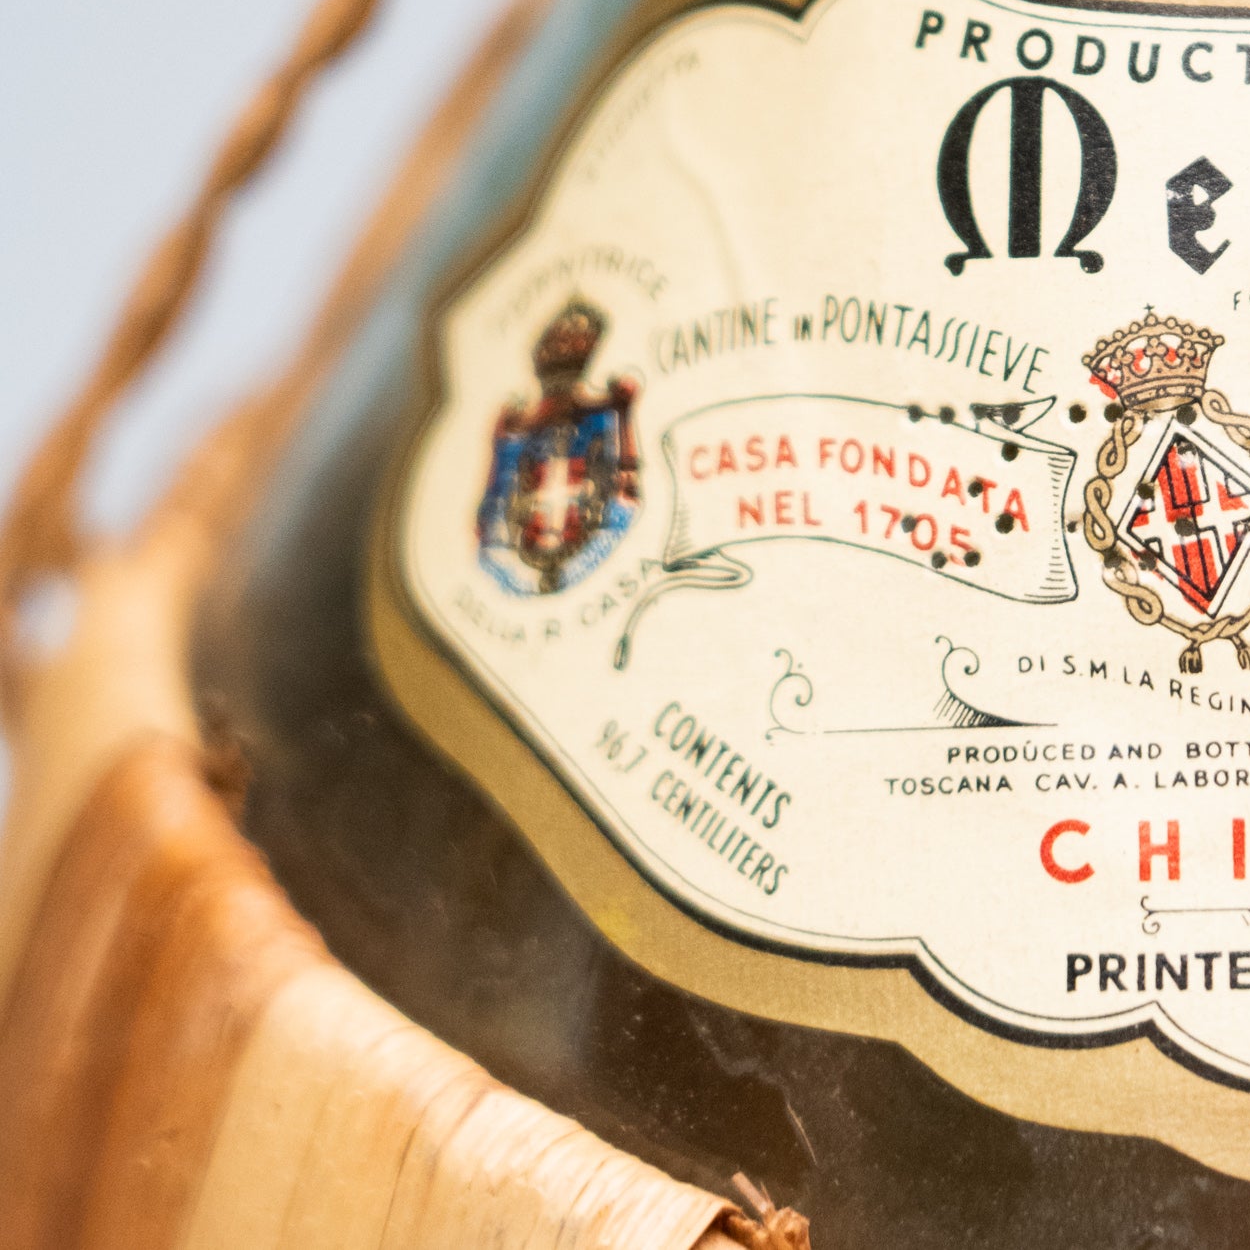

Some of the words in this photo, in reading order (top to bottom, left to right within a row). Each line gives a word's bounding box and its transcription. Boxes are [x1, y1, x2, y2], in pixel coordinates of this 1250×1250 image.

[655, 296, 778, 375] CANTINE
[821, 294, 1051, 395] PONTASSIEVE
[689, 434, 798, 481] CASA
[818, 436, 1031, 534] FONDATA
[736, 490, 822, 529] NEL
[852, 499, 975, 567] 1705
[1018, 654, 1046, 674] DI
[1123, 665, 1154, 691] LA
[653, 700, 792, 830] CONTENTS
[883, 774, 1014, 797] TOSCANA
[1034, 772, 1099, 793] CAV.
[1108, 742, 1163, 761] AND
[650, 769, 790, 896] CENTILITERS
